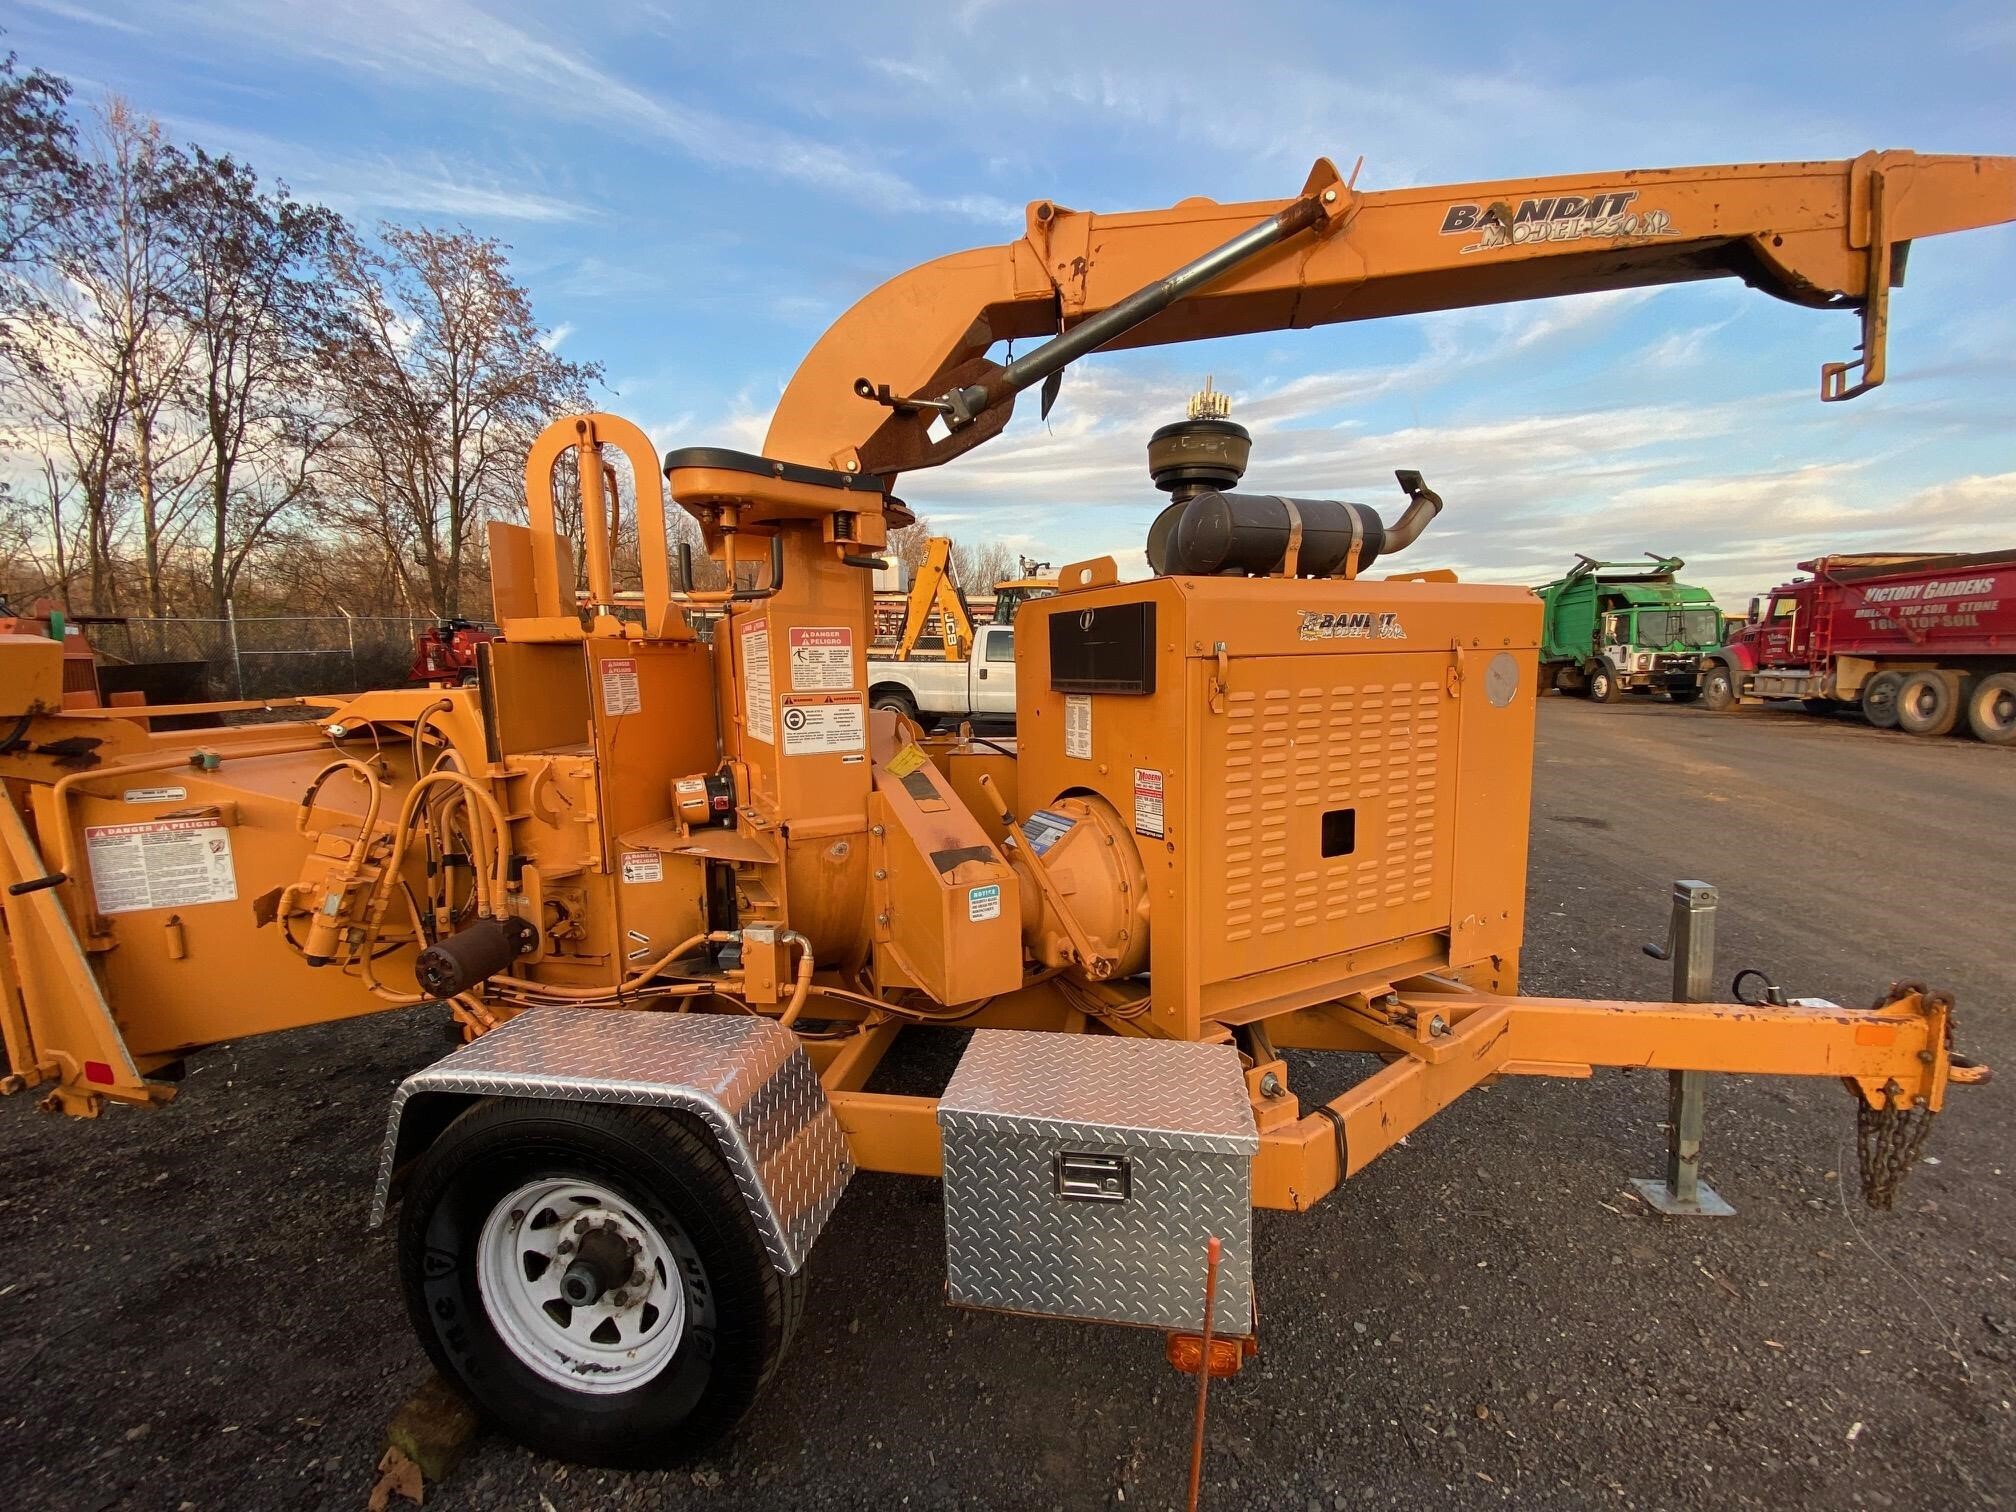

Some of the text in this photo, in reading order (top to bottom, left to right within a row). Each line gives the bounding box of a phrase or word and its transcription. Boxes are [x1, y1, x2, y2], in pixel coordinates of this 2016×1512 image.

[1439, 190, 1637, 233] BANDIT
[1864, 578, 1995, 602] VICTORY GARDENS
[1899, 605, 1921, 616] TOP
[1922, 603, 1948, 615] SOIL
[1957, 600, 2000, 612] STONE
[943, 612, 958, 646] JCB
[1910, 616, 1940, 629] TOP
[1942, 614, 1979, 627] SOIL
[107, 820, 218, 835] DANGER PELIGRO
[973, 888, 996, 898] NOTICE
